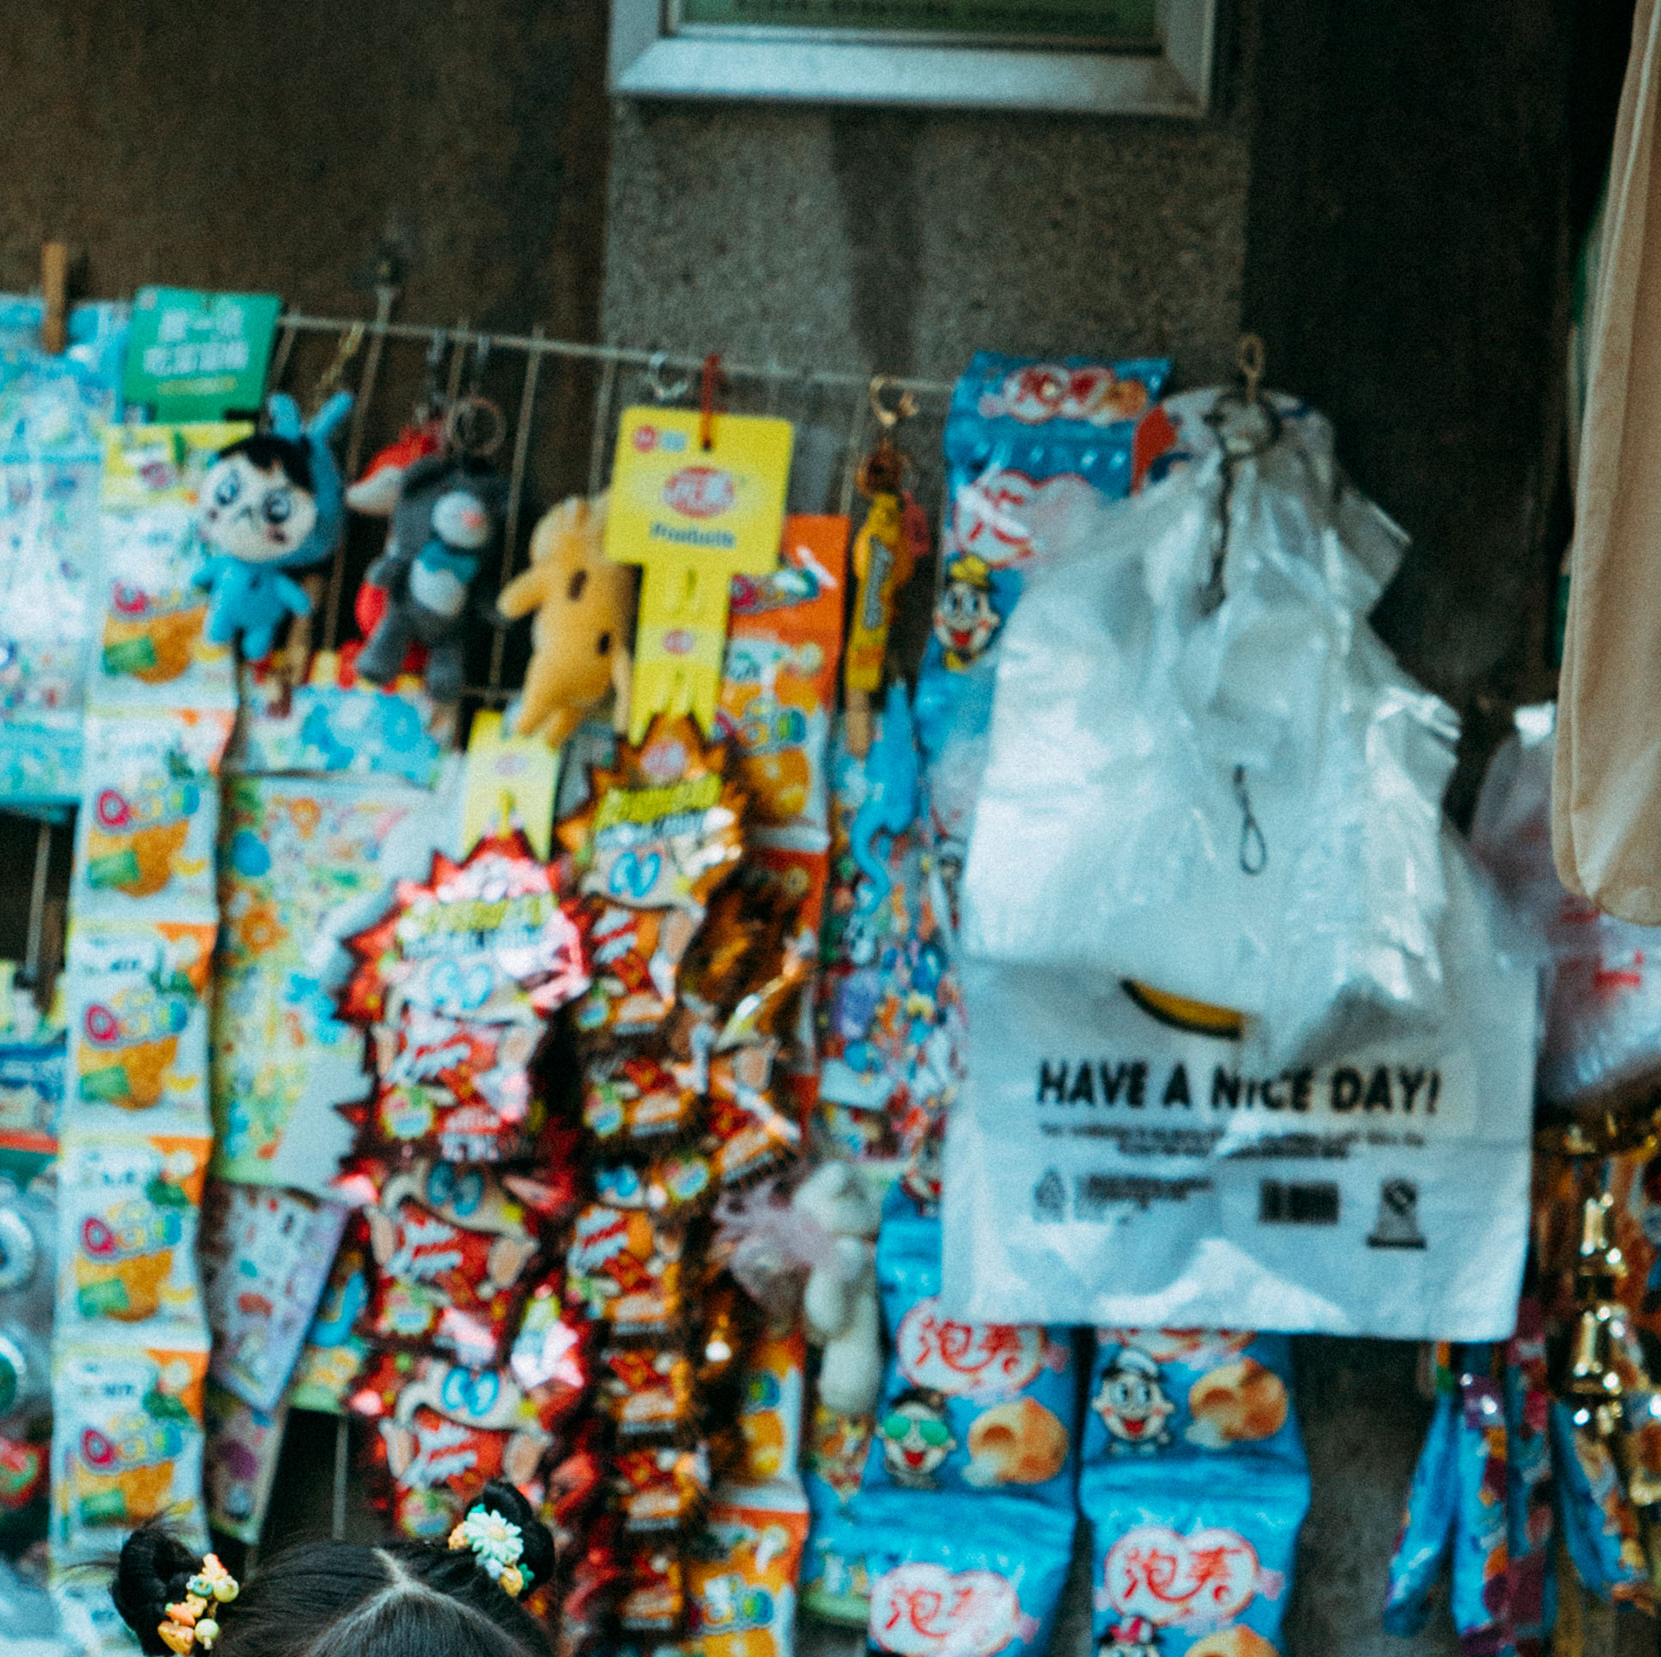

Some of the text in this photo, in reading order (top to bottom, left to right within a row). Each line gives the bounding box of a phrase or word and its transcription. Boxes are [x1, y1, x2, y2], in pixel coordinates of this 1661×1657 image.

[1038, 1059, 1441, 1114] HAVE A NICE DAY!
[1122, 1545, 1245, 1604] 泡芙
